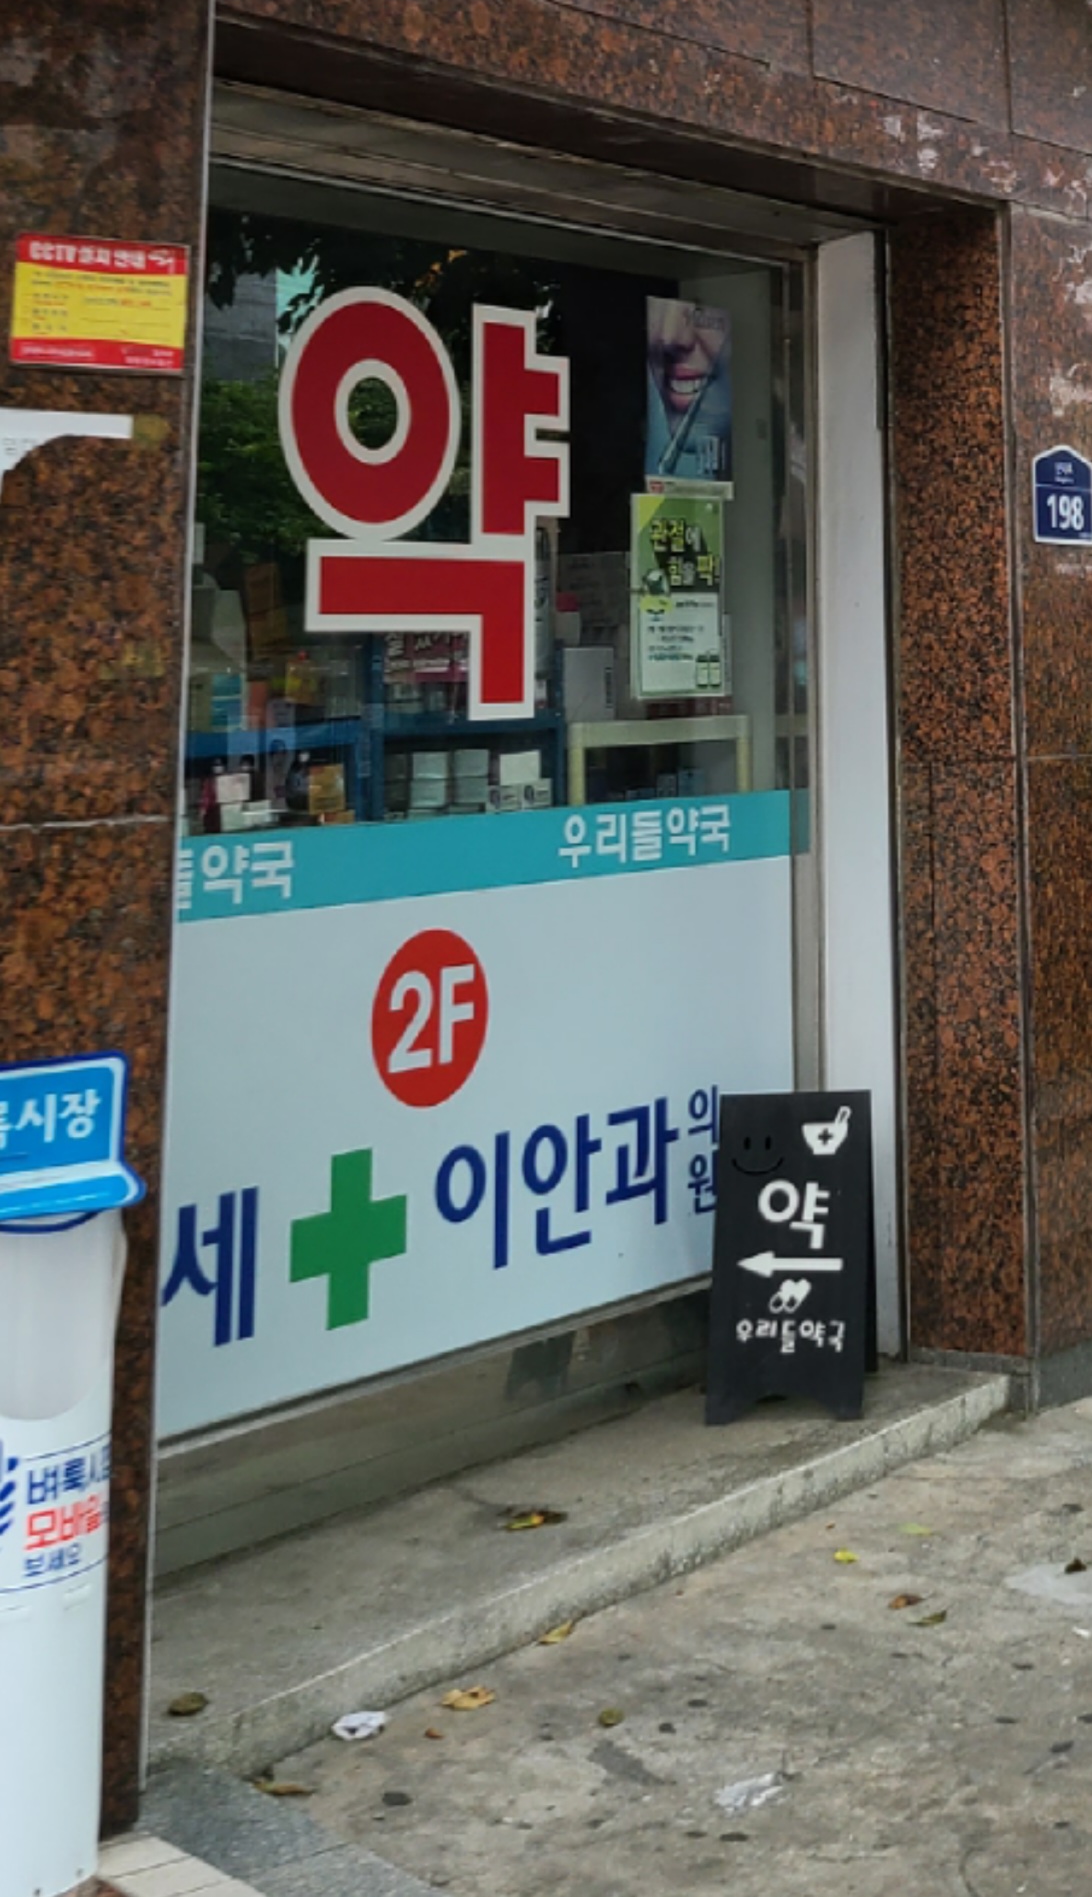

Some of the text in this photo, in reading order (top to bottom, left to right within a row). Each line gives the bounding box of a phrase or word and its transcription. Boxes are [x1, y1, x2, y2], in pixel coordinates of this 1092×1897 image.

[278, 286, 571, 721] 약
[1046, 493, 1085, 531] 198
[558, 804, 732, 868] 우리들약국
[387, 964, 476, 1075] 2F
[160, 1186, 260, 1348] 세
[434, 1097, 680, 1270] 이안과
[757, 1179, 830, 1250] 약
[735, 1317, 846, 1354] 우리들약국
